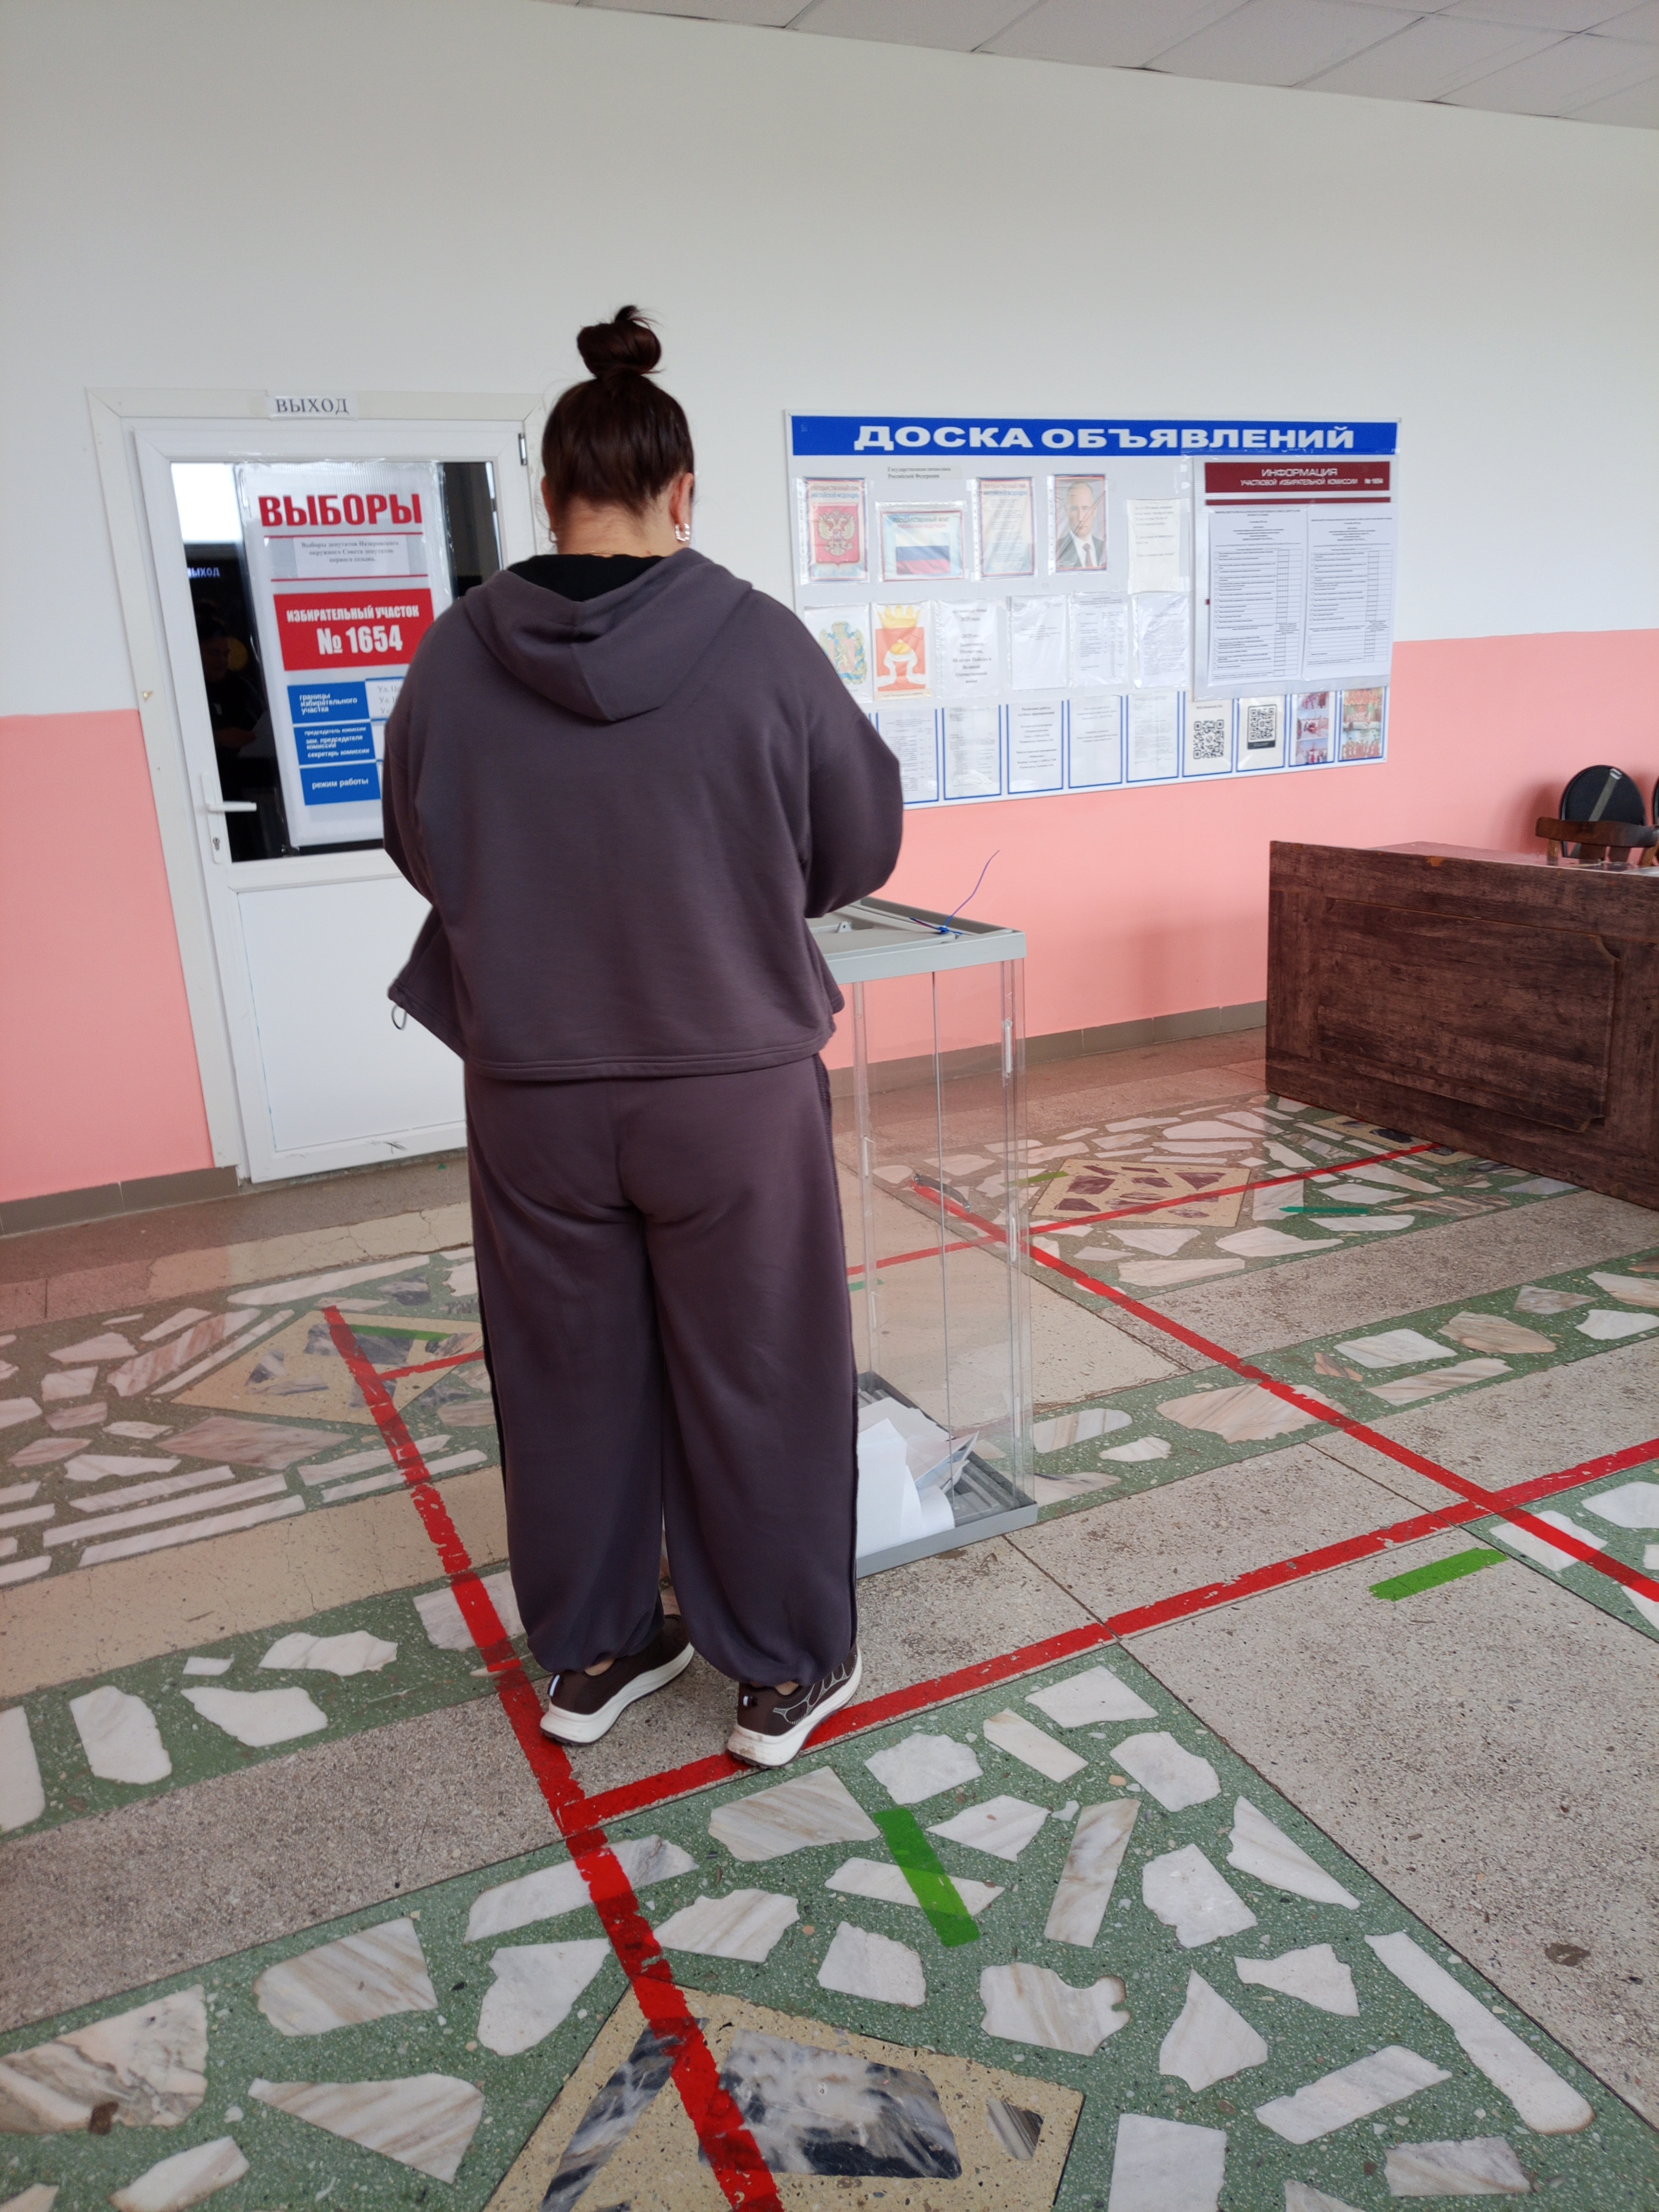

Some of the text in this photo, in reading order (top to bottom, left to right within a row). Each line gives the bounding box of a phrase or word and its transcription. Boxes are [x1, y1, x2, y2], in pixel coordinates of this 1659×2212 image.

[275, 398, 349, 415] ВЫХОД
[854, 425, 1354, 451] ДОСКА ОБЪЯВЛЕНИЙ
[1261, 468, 1338, 477] ИНФОРМАЦИЯ
[258, 493, 422, 527] ВЫБОРЫ
[286, 605, 419, 623] ИЗБИРАТЕЛЬНЫЙ УЧАСТОК
[316, 624, 403, 655] № 1654
[300, 693, 330, 702] границы
[301, 697, 358, 708] избирательного
[301, 706, 329, 716] участка
[304, 728, 340, 736] председатель
[320, 734, 363, 744] председателя
[308, 750, 339, 759] секретарь
[312, 778, 369, 790] режим работы
